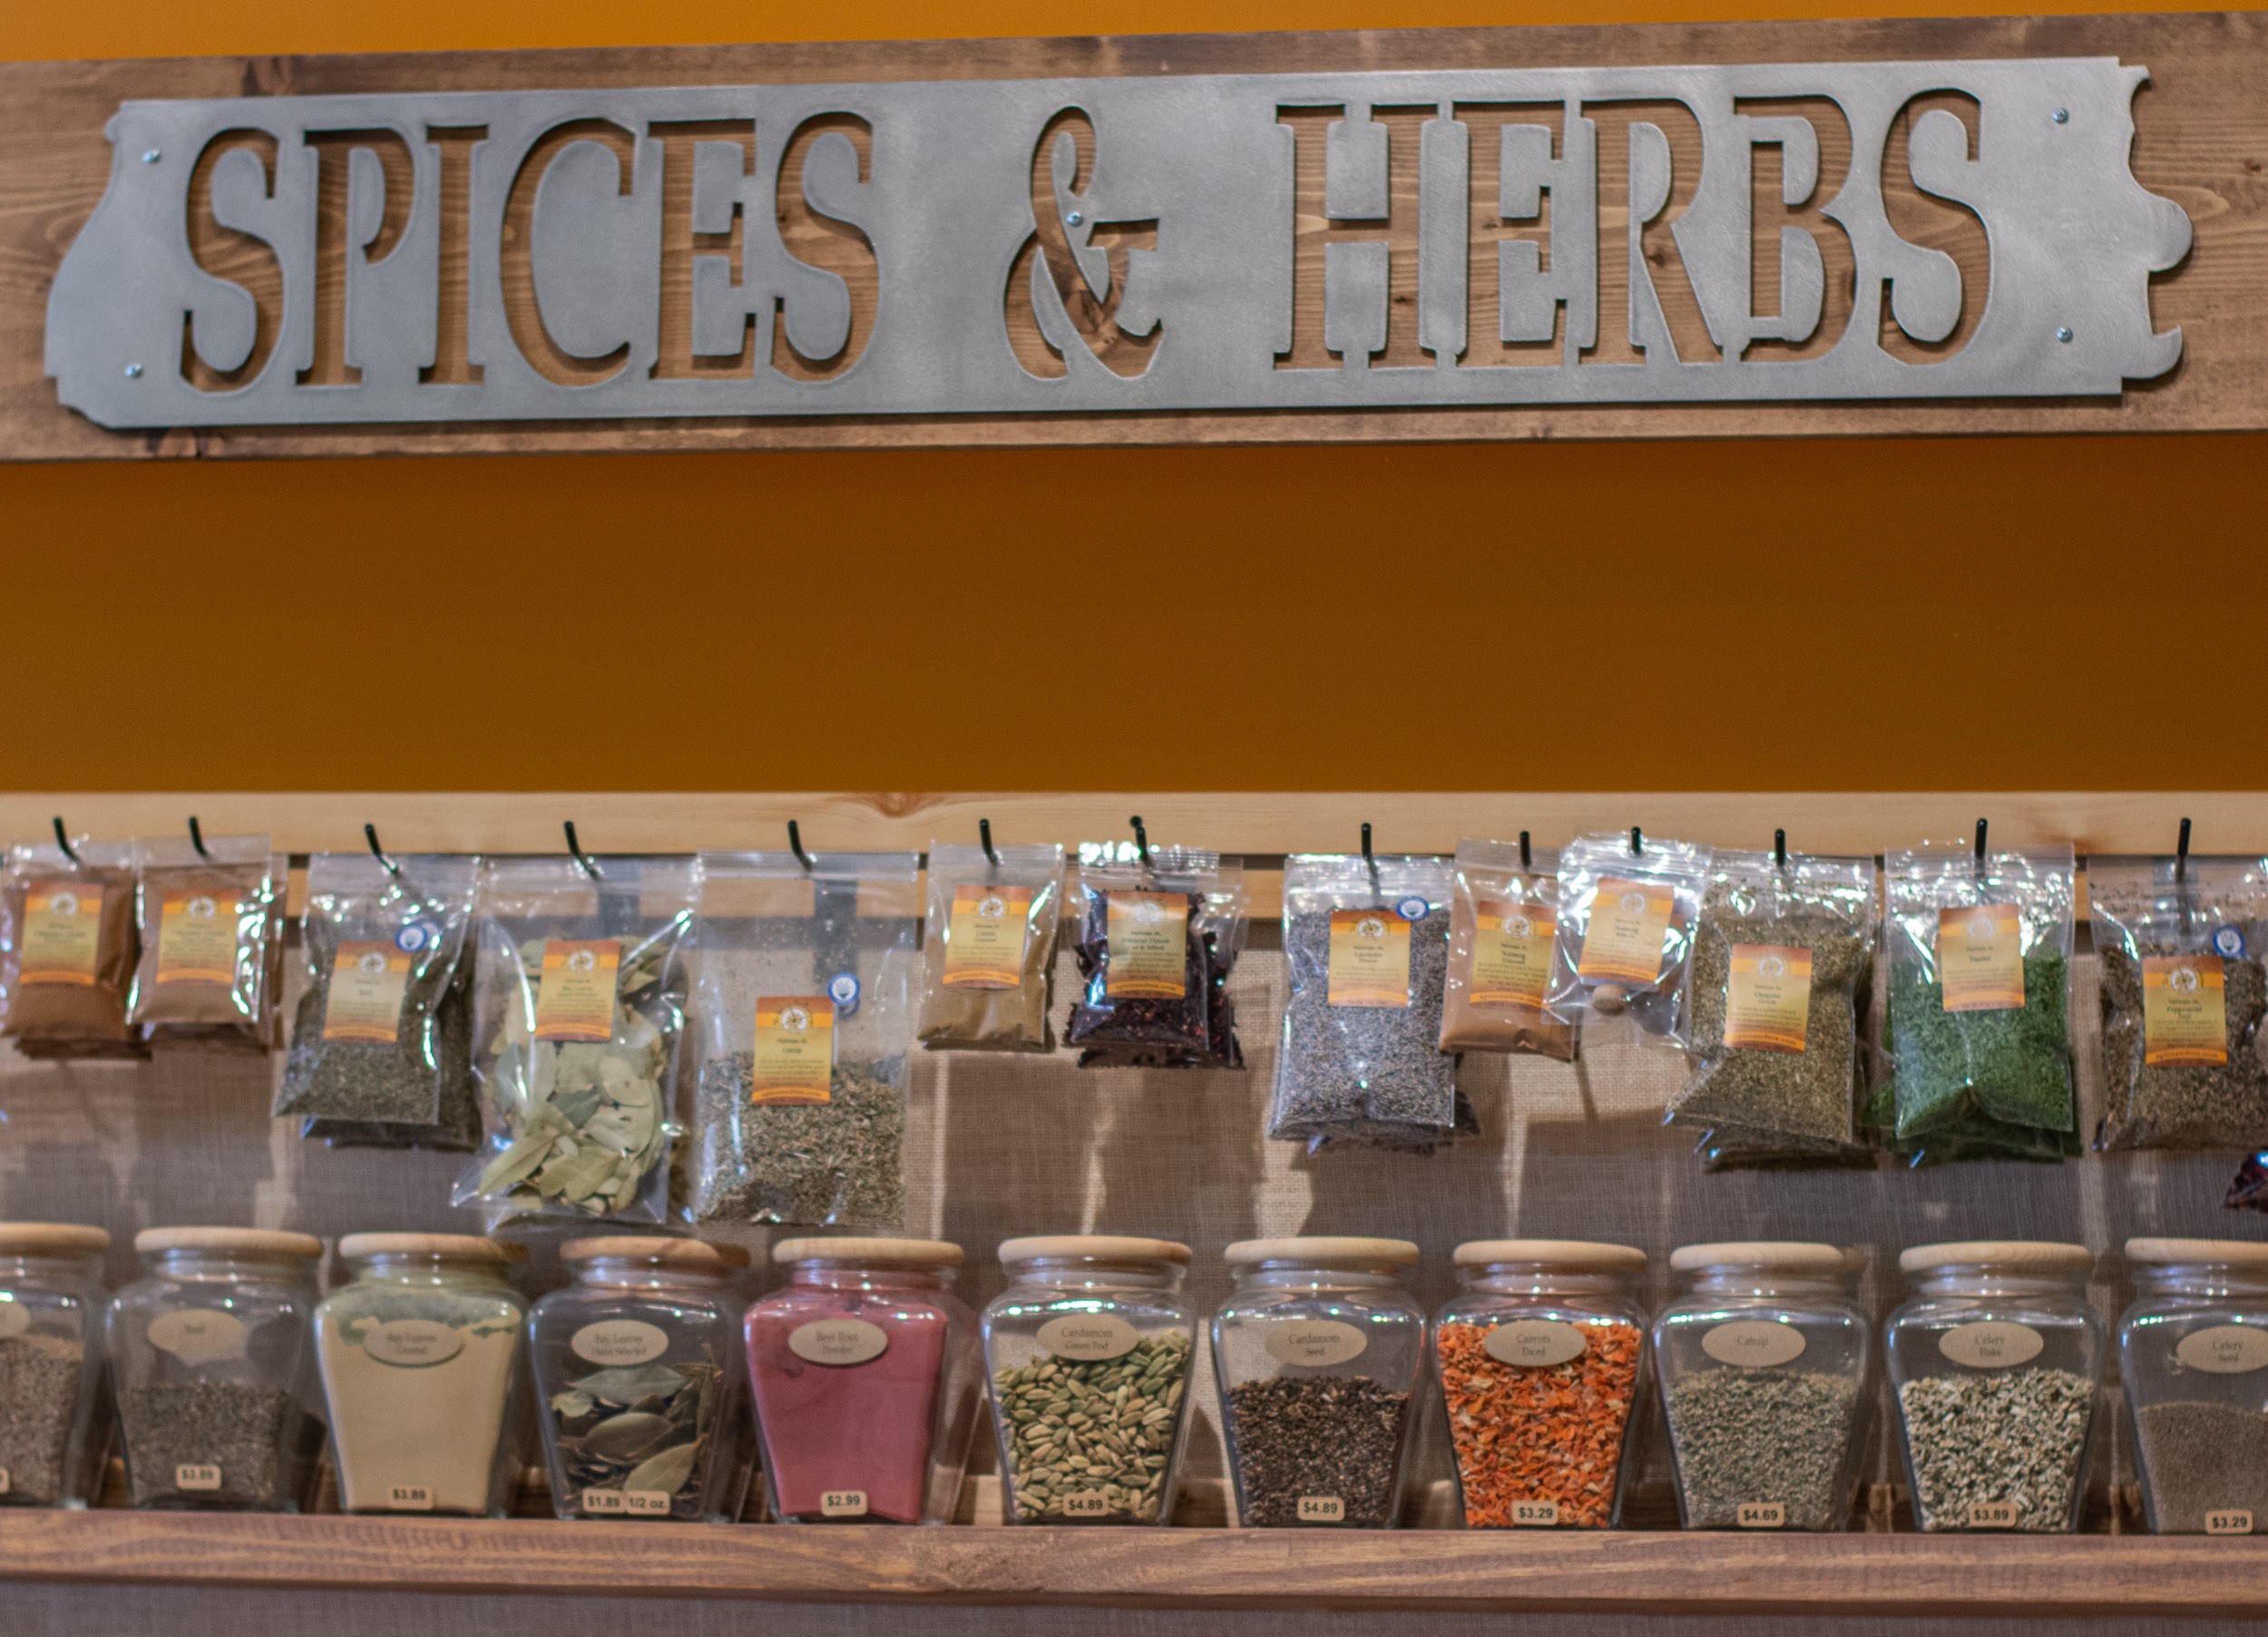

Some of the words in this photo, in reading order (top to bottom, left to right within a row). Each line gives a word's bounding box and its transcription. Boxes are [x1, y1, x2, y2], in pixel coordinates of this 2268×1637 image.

[180, 111, 881, 394] SPICES
[1003, 105, 1164, 380] &
[1272, 87, 1993, 371] HERBS
[1061, 1327, 1113, 1338] Cardamom
[1288, 1334, 1341, 1344] Cardamom
[1516, 1333, 1551, 1344] Carrots
[1736, 1335, 1770, 1349] Catnip
[588, 1496, 621, 1507] $1.89
[826, 1495, 861, 1506] $2.99
[1069, 1498, 1103, 1511] $4.89
[1304, 1501, 1338, 1514] $4.89
[1519, 1506, 1553, 1519] $3.29
[1743, 1509, 1778, 1522] $4.69
[1973, 1509, 2009, 1522] $3.89
[2212, 1515, 2248, 1530] $3.29
